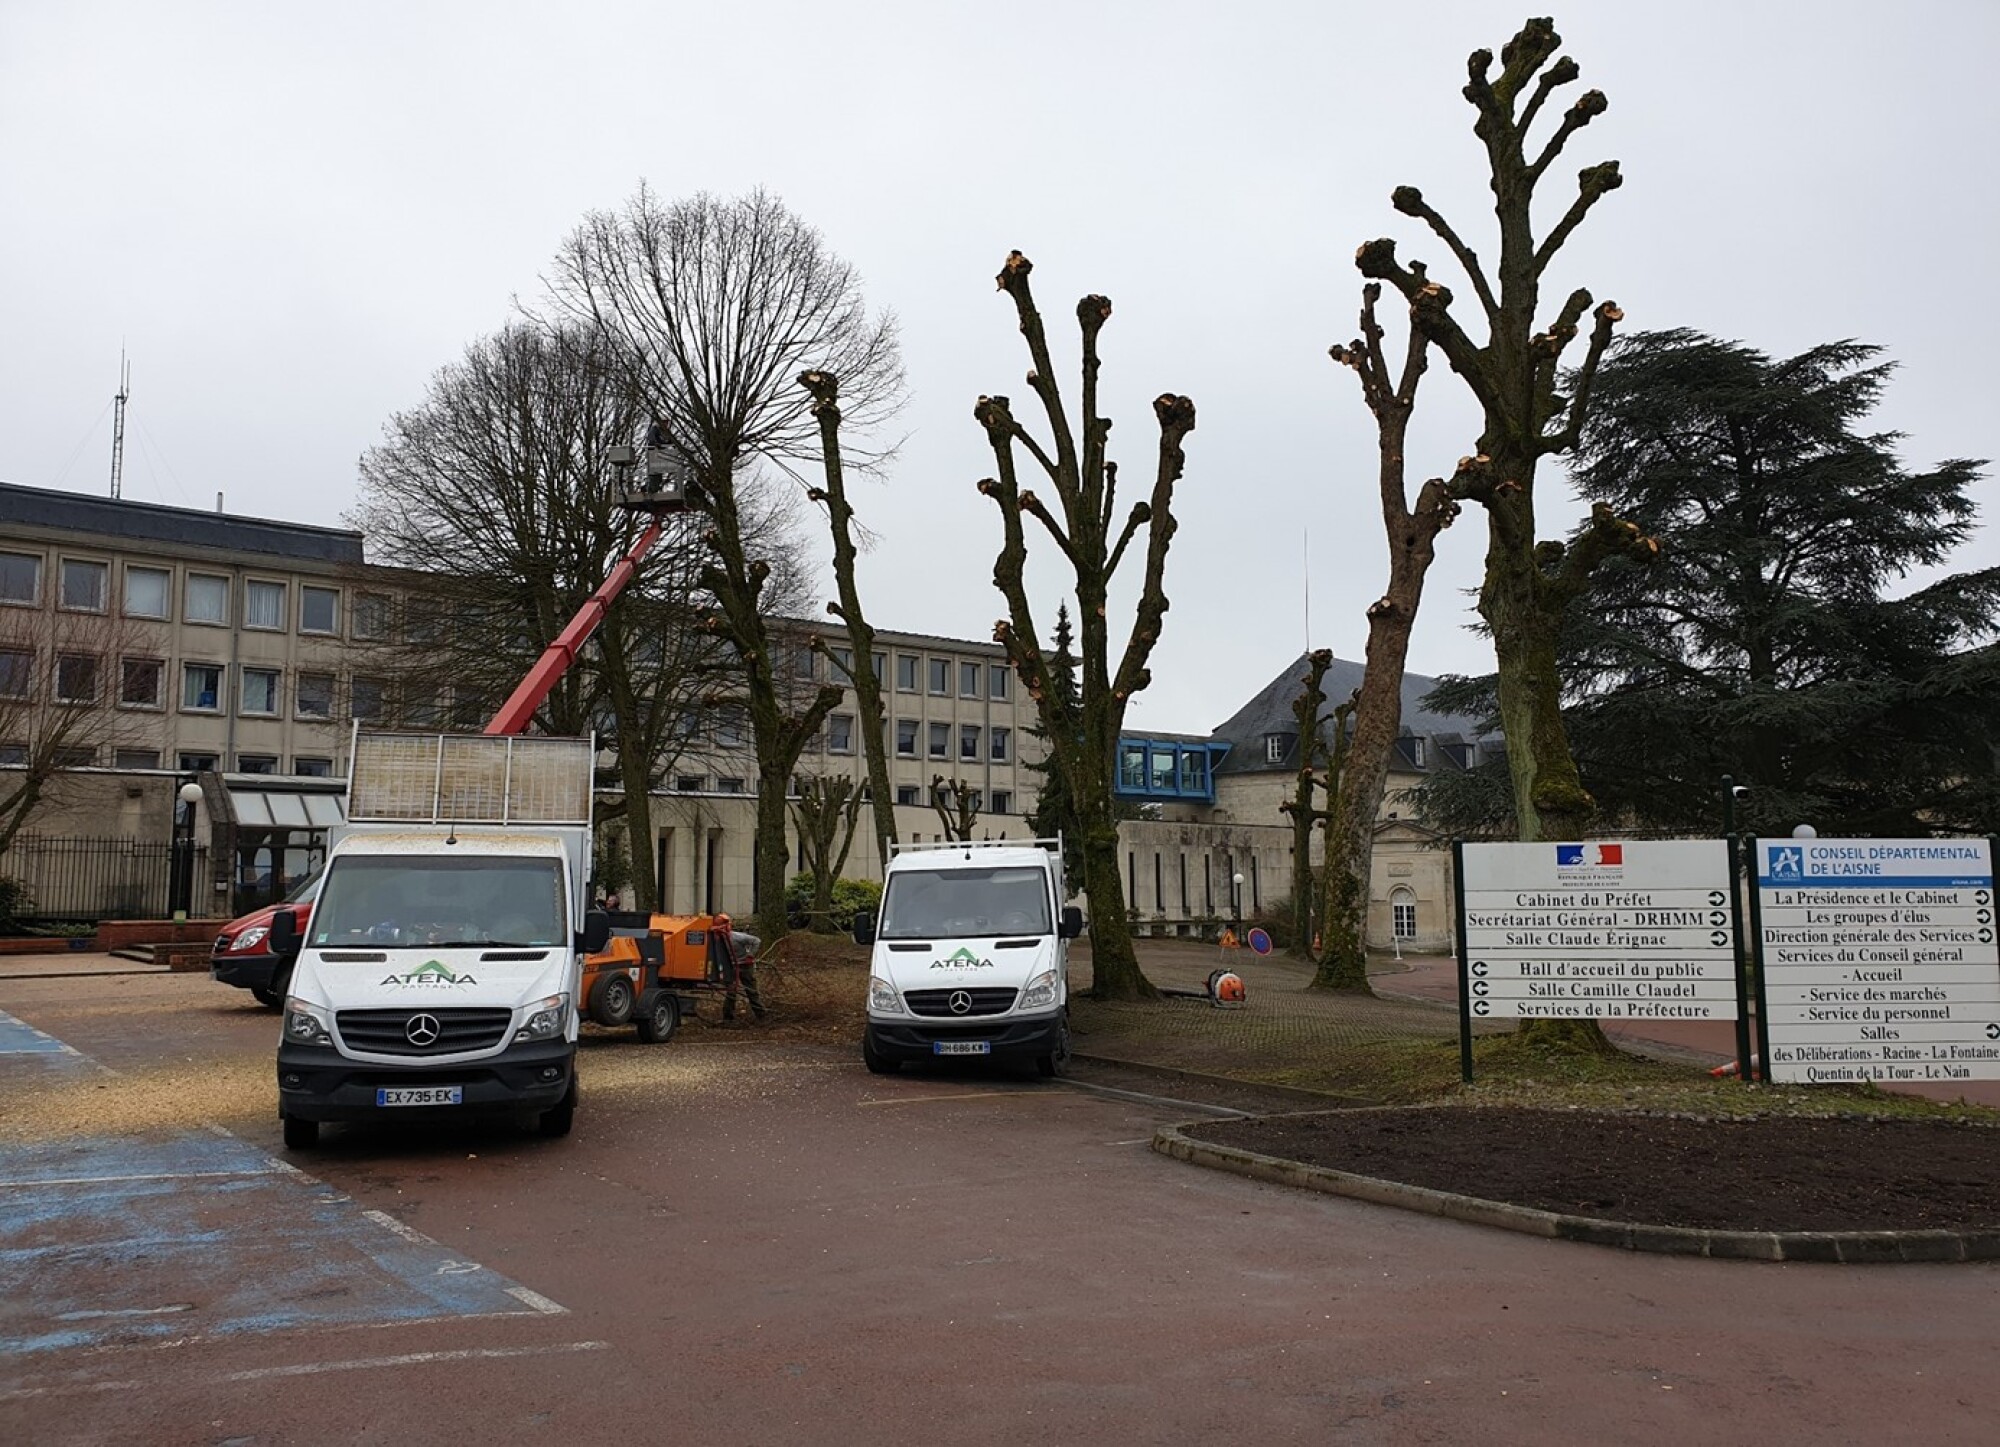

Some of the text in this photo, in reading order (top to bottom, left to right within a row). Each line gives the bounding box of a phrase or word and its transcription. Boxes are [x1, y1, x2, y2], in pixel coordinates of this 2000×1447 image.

[1810, 845, 1982, 860] CONSEIL DÉPARTEMENTAL
[1811, 863, 1881, 875] DE L'AISNE
[1516, 893, 1652, 907] Cabinet du Préfet
[1774, 890, 1959, 905] La Présidence et le Cabinet
[1468, 911, 1551, 927] Secrétariat
[1557, 911, 1617, 927] Général
[1634, 911, 1704, 926] DRHMM
[1806, 910, 1931, 926] Les groupes d'élus
[1506, 928, 1667, 949] Salle Claude Érignac
[1764, 928, 1975, 946] Direction générale des Services
[930, 958, 994, 969] ATENA
[1777, 948, 1963, 965] Services du Conseil général
[1520, 962, 1705, 980] Hall d'accueil du public
[1851, 967, 1903, 982] Accueil
[379, 973, 478, 986] ATENA
[1528, 982, 1696, 998] Salle Camille Claudel
[1809, 987, 1860, 1001] Service
[1863, 987, 1886, 1001] des
[1889, 986, 1947, 1001] marchés
[1517, 1002, 1711, 1018] Services de la Préfecture
[1808, 1007, 1859, 1021] Service
[1862, 1007, 1880, 1021] du
[1884, 1006, 1951, 1023] personnel
[1860, 1026, 1900, 1040] Salles
[1774, 1048, 1793, 1061] des
[1796, 1046, 1872, 1061] Délibérations
[1882, 1046, 1921, 1060] Racine
[1931, 1045, 1947, 1059] La
[1950, 1044, 2000, 1059] Fontaine
[1806, 1066, 1854, 1082] Quentin
[1856, 1066, 1871, 1080] de
[1873, 1066, 1884, 1079] la
[1885, 1065, 1915, 1079] Tour
[1925, 1065, 1941, 1078] Le
[1943, 1065, 1971, 1079] Nain
[386, 1090, 452, 1103] EX-735-EK
